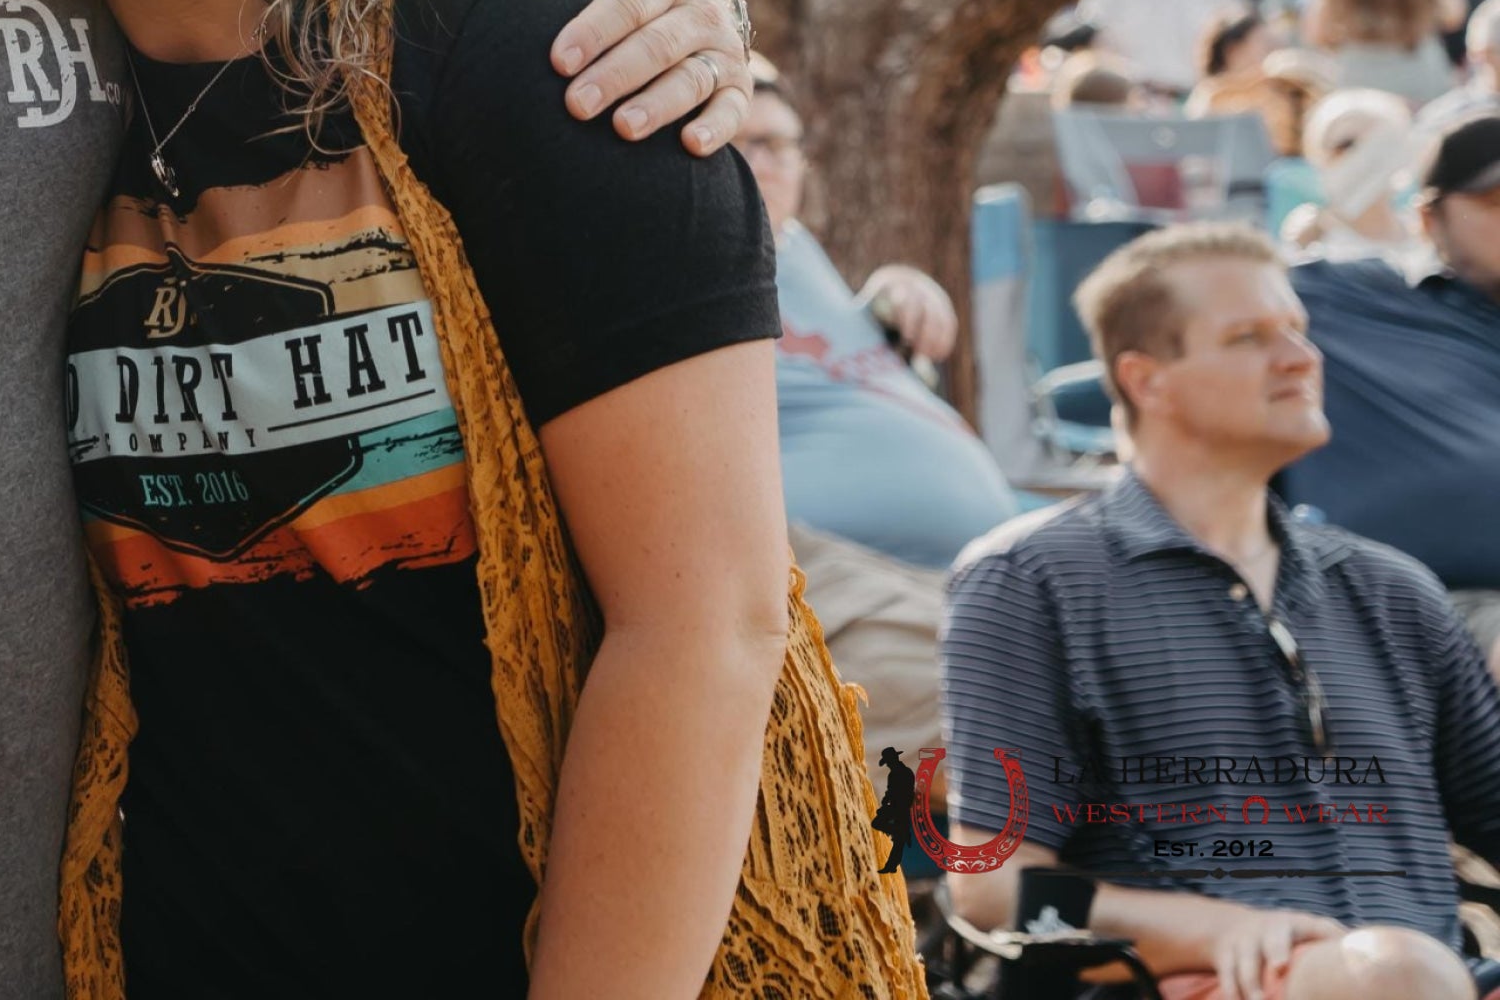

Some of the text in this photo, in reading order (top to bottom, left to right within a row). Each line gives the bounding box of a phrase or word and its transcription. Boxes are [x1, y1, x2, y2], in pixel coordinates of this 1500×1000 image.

[115, 353, 238, 424] DIRT
[284, 311, 427, 411] HAT
[104, 427, 257, 453] COMPANY
[139, 469, 249, 507] EST. 2016
